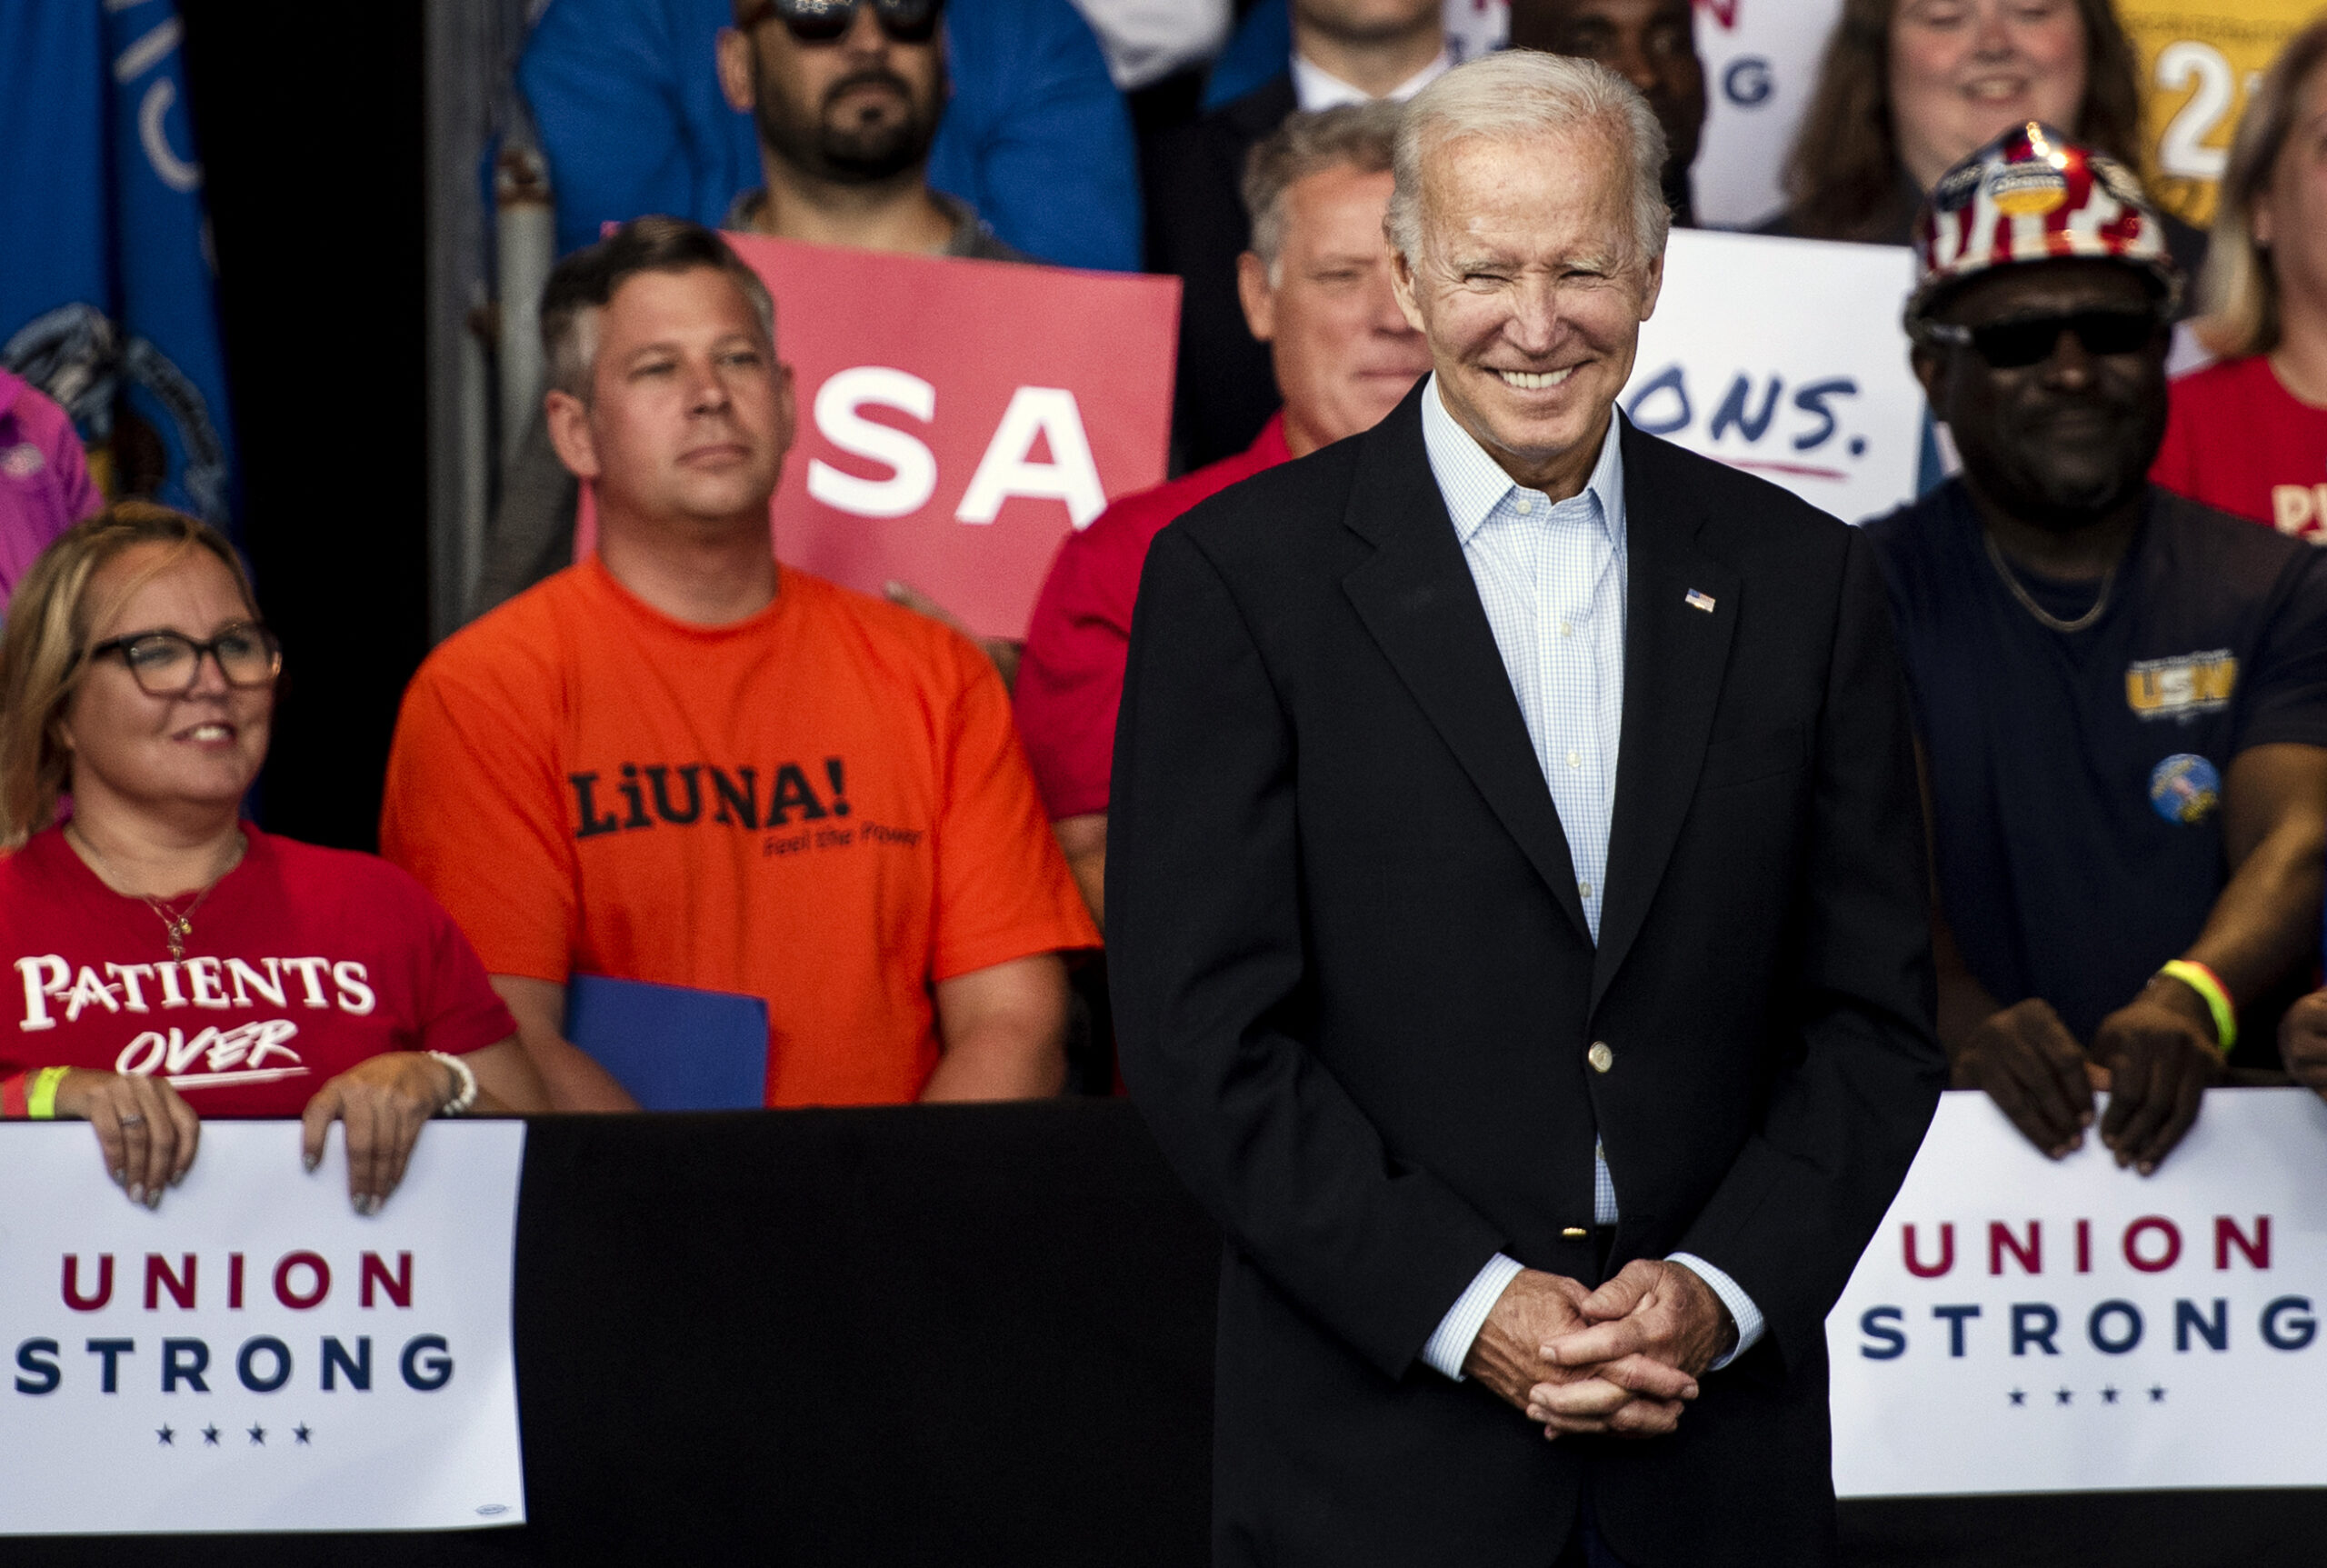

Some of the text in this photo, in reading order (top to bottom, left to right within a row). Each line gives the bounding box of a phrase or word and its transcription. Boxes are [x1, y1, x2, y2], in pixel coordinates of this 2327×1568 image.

[570, 756, 852, 839] LiUNA!
[814, 825, 855, 849] the
[13, 954, 376, 1032] PATIENTS
[115, 1018, 303, 1077] OVER
[1901, 1214, 2272, 1279] UNION
[61, 1251, 415, 1313] UNION
[1859, 1294, 2319, 1361] STRONG
[14, 1333, 456, 1396] STRONG
